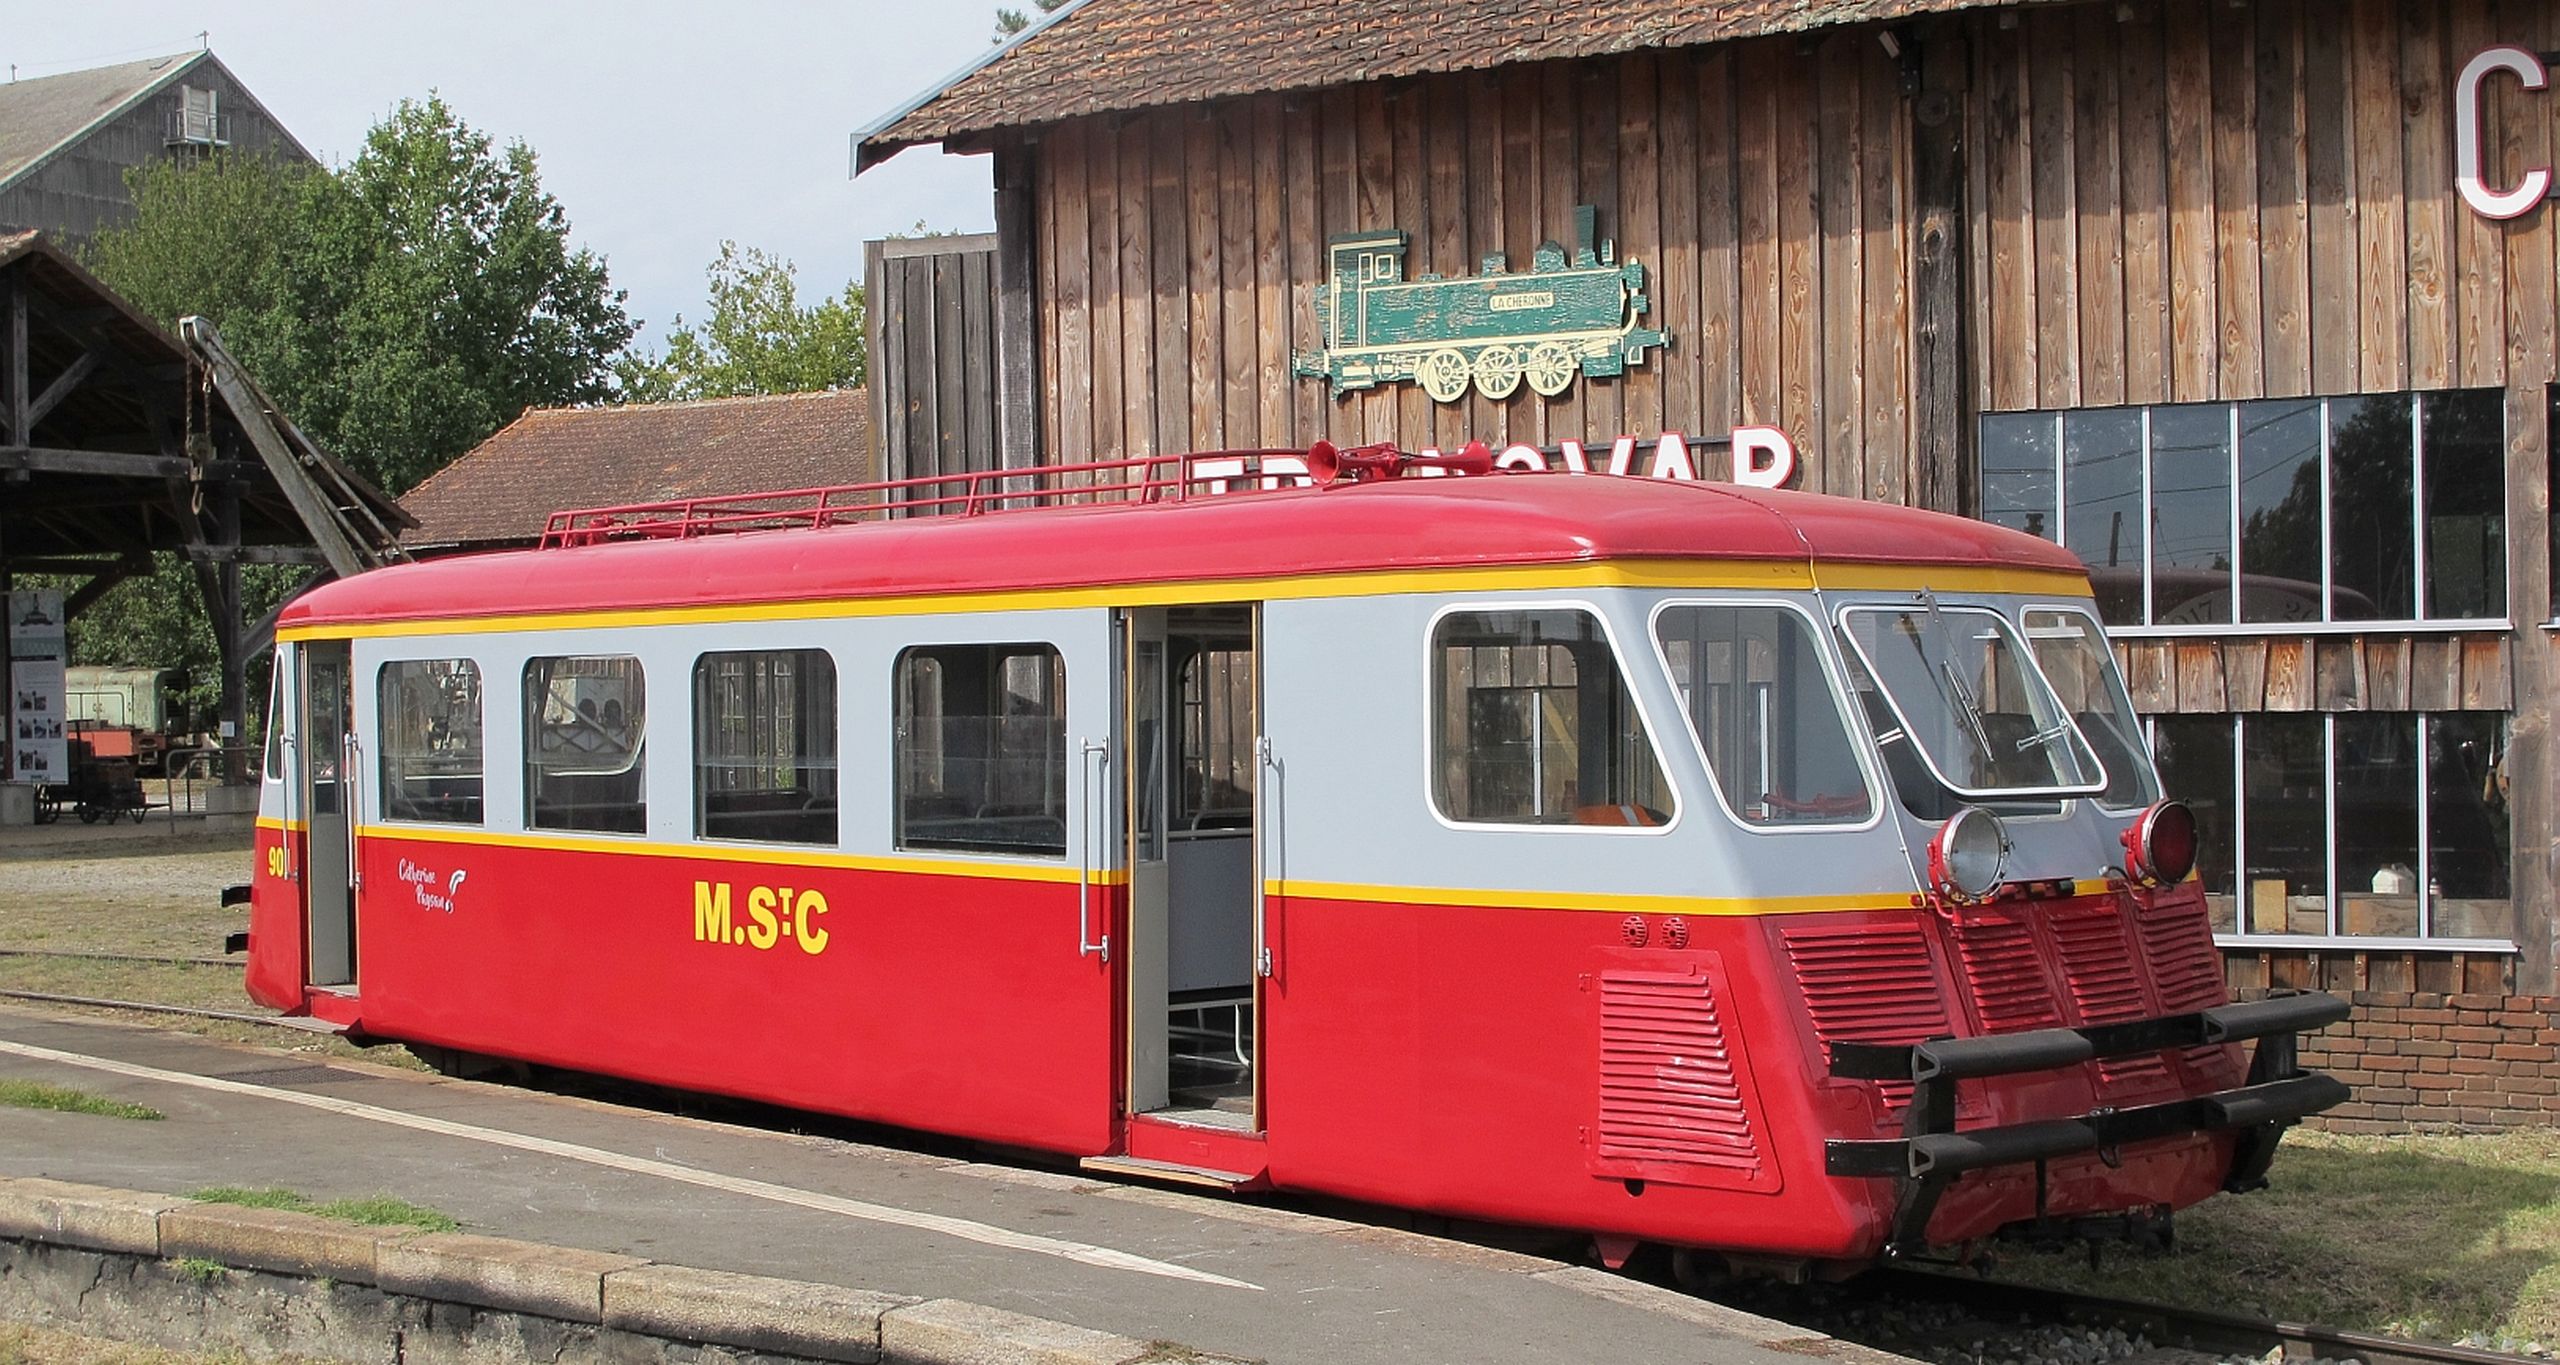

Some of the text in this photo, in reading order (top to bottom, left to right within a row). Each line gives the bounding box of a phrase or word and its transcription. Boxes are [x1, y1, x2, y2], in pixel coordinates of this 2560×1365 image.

[2453, 44, 2552, 220] C
[1492, 293, 1552, 309] LA CHERONNE
[398, 857, 436, 885] Catherine
